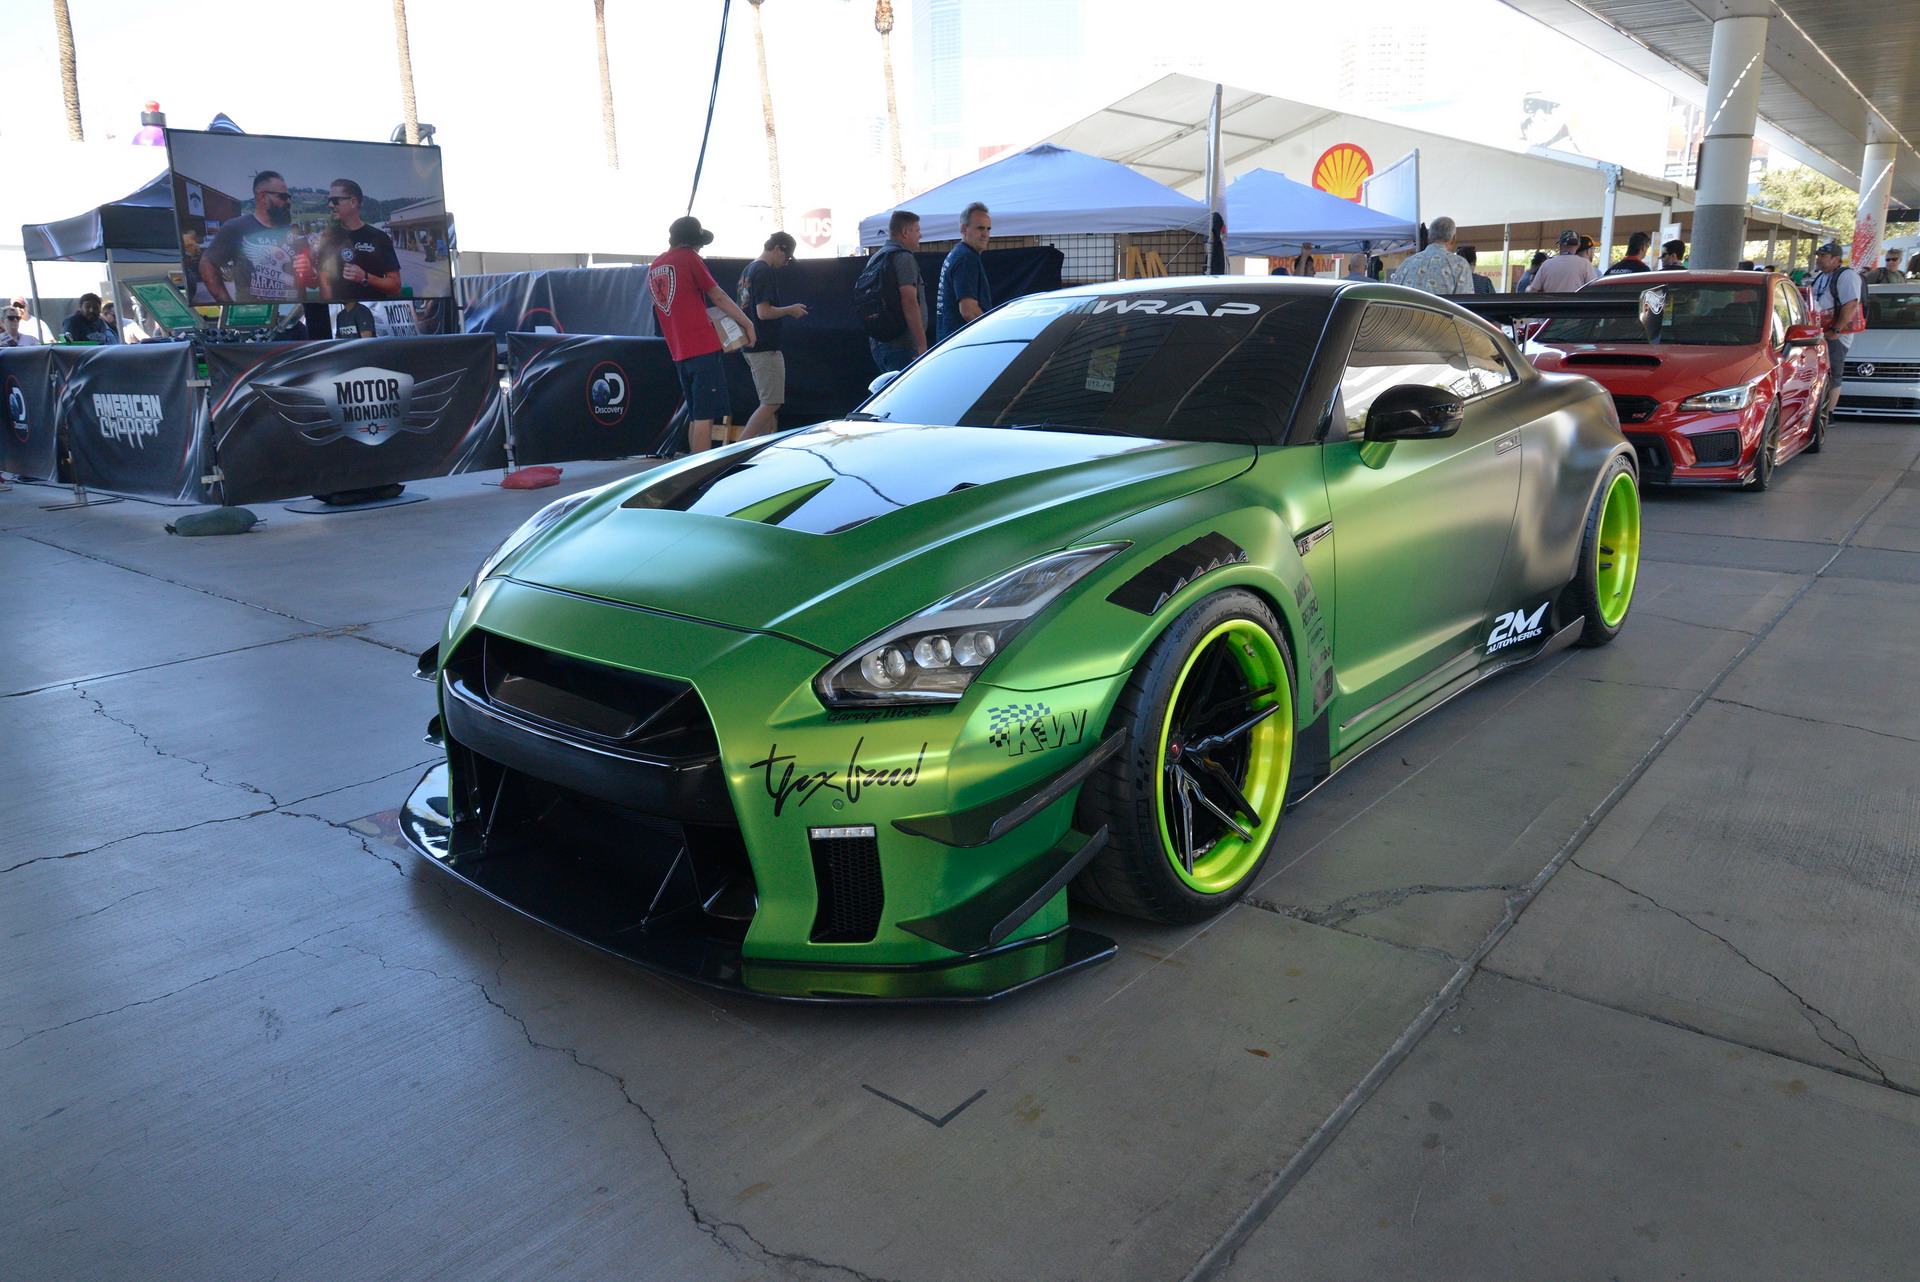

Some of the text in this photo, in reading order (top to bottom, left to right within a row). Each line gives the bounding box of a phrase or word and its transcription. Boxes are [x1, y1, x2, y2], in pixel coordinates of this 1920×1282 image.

[384, 303, 414, 325] MOTOR
[1092, 300, 1261, 318] WRAP
[333, 378, 401, 405] MOTOR
[92, 393, 163, 420] AMERICAN
[342, 403, 400, 422] MONDAYS
[594, 405, 624, 415] Discovery
[1486, 601, 1550, 647] 2M
[1485, 627, 1543, 655] AUTOWERKS
[827, 707, 931, 724] Garage Works
[1008, 708, 1088, 757] KW
